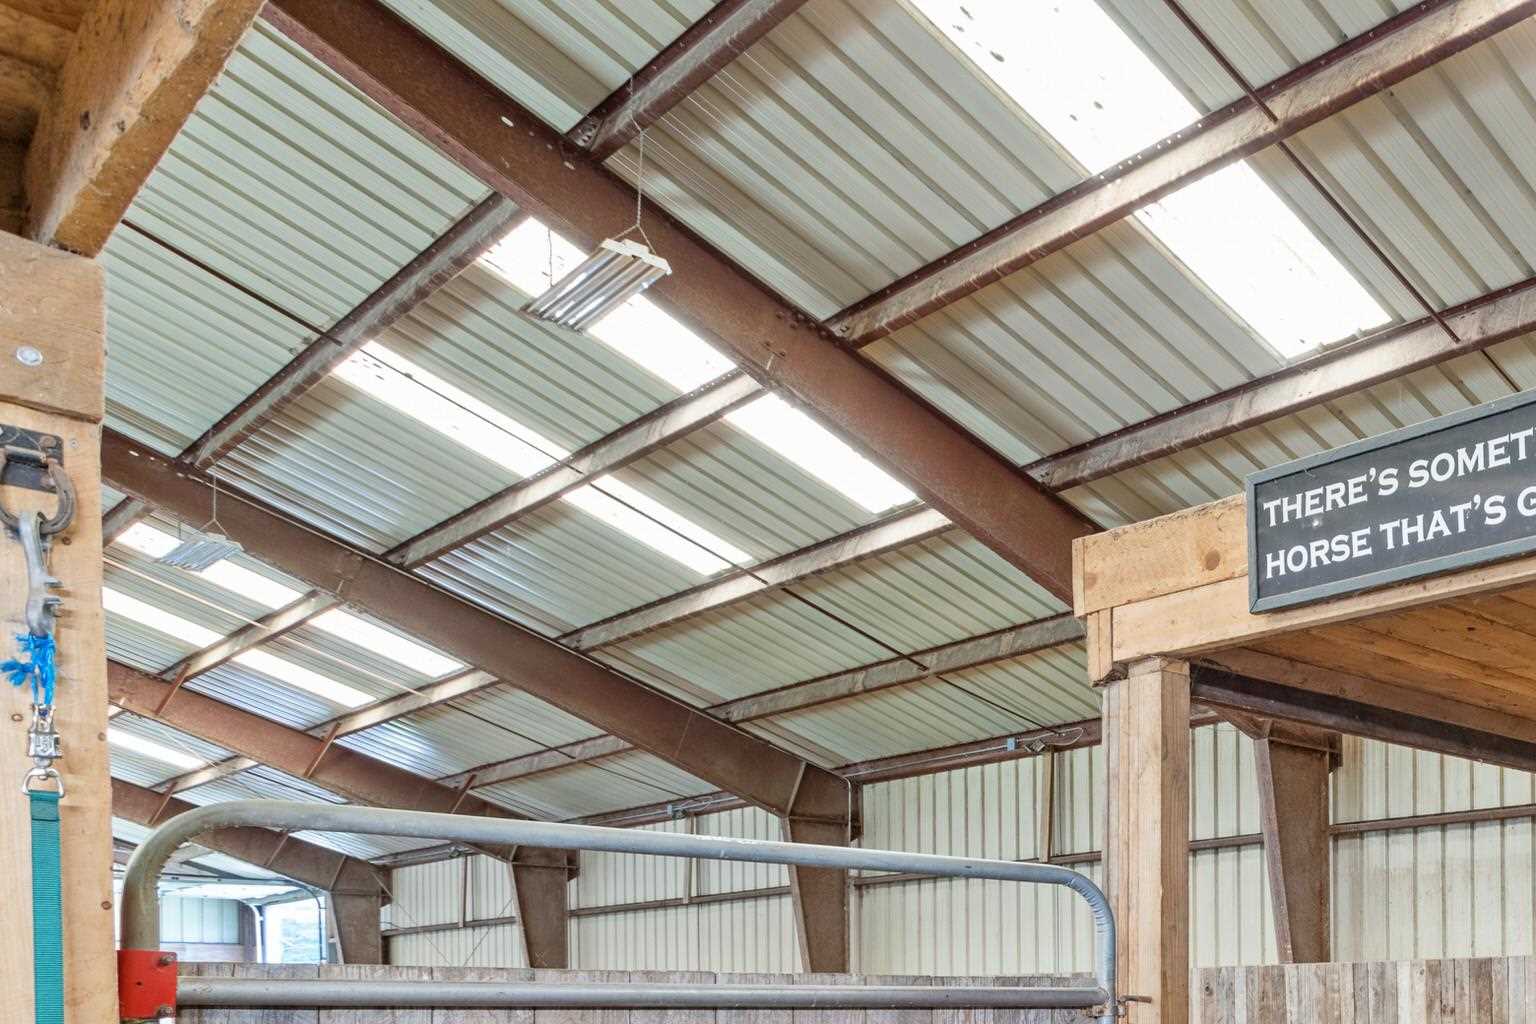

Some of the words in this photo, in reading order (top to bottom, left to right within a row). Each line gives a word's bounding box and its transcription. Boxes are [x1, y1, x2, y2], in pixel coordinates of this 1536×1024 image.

[1262, 467, 1399, 528] THERE'S
[1265, 525, 1373, 580] HORSE
[1378, 493, 1508, 550] THAT'S
